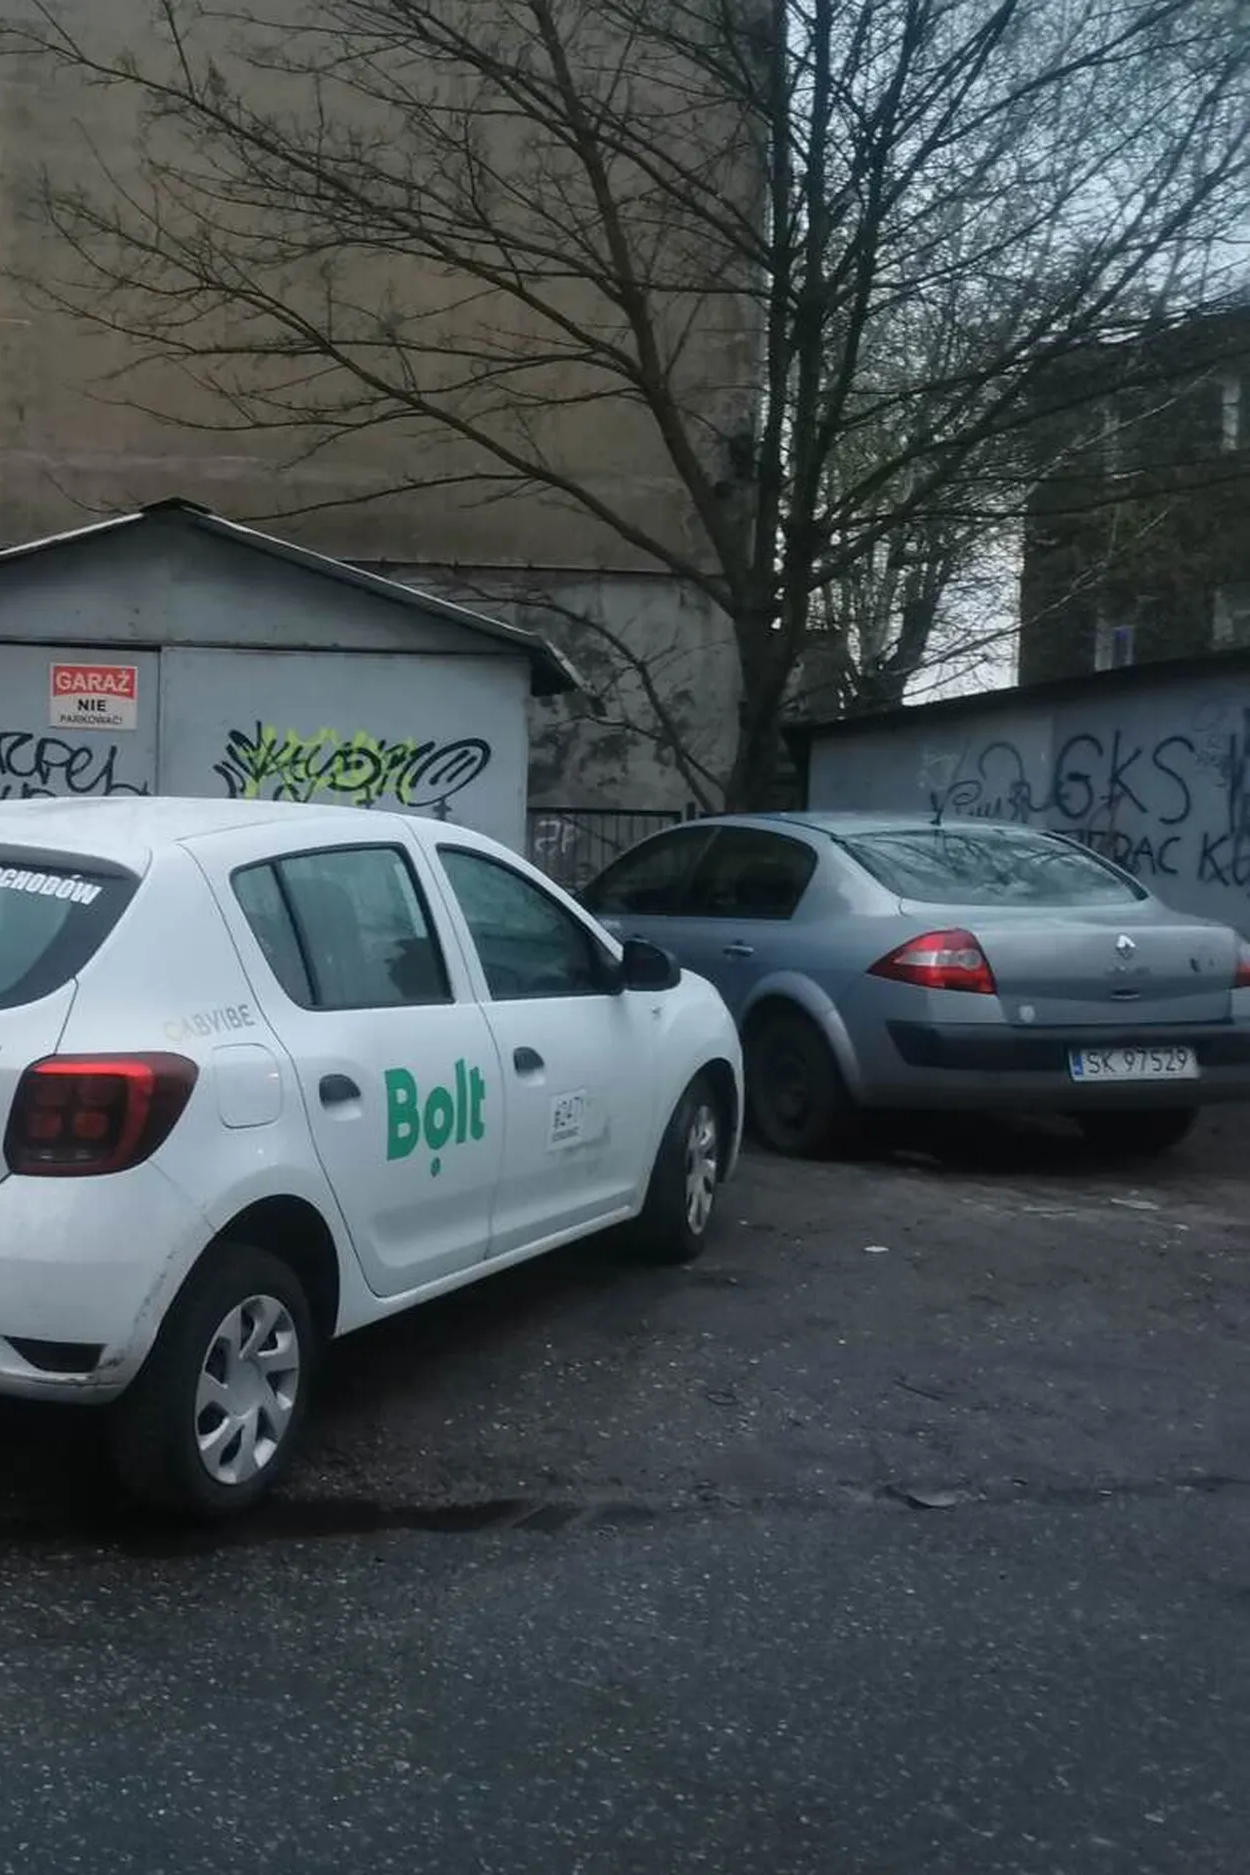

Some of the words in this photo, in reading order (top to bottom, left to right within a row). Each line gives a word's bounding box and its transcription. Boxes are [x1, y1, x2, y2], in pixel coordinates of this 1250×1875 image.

[56, 670, 131, 692] GARAŻ
[77, 699, 107, 712] NIE
[1053, 729, 1196, 824] GKS
[1087, 1052, 1115, 1074] SK
[1125, 1049, 1188, 1071] 97529
[384, 1057, 486, 1178] Bolt
